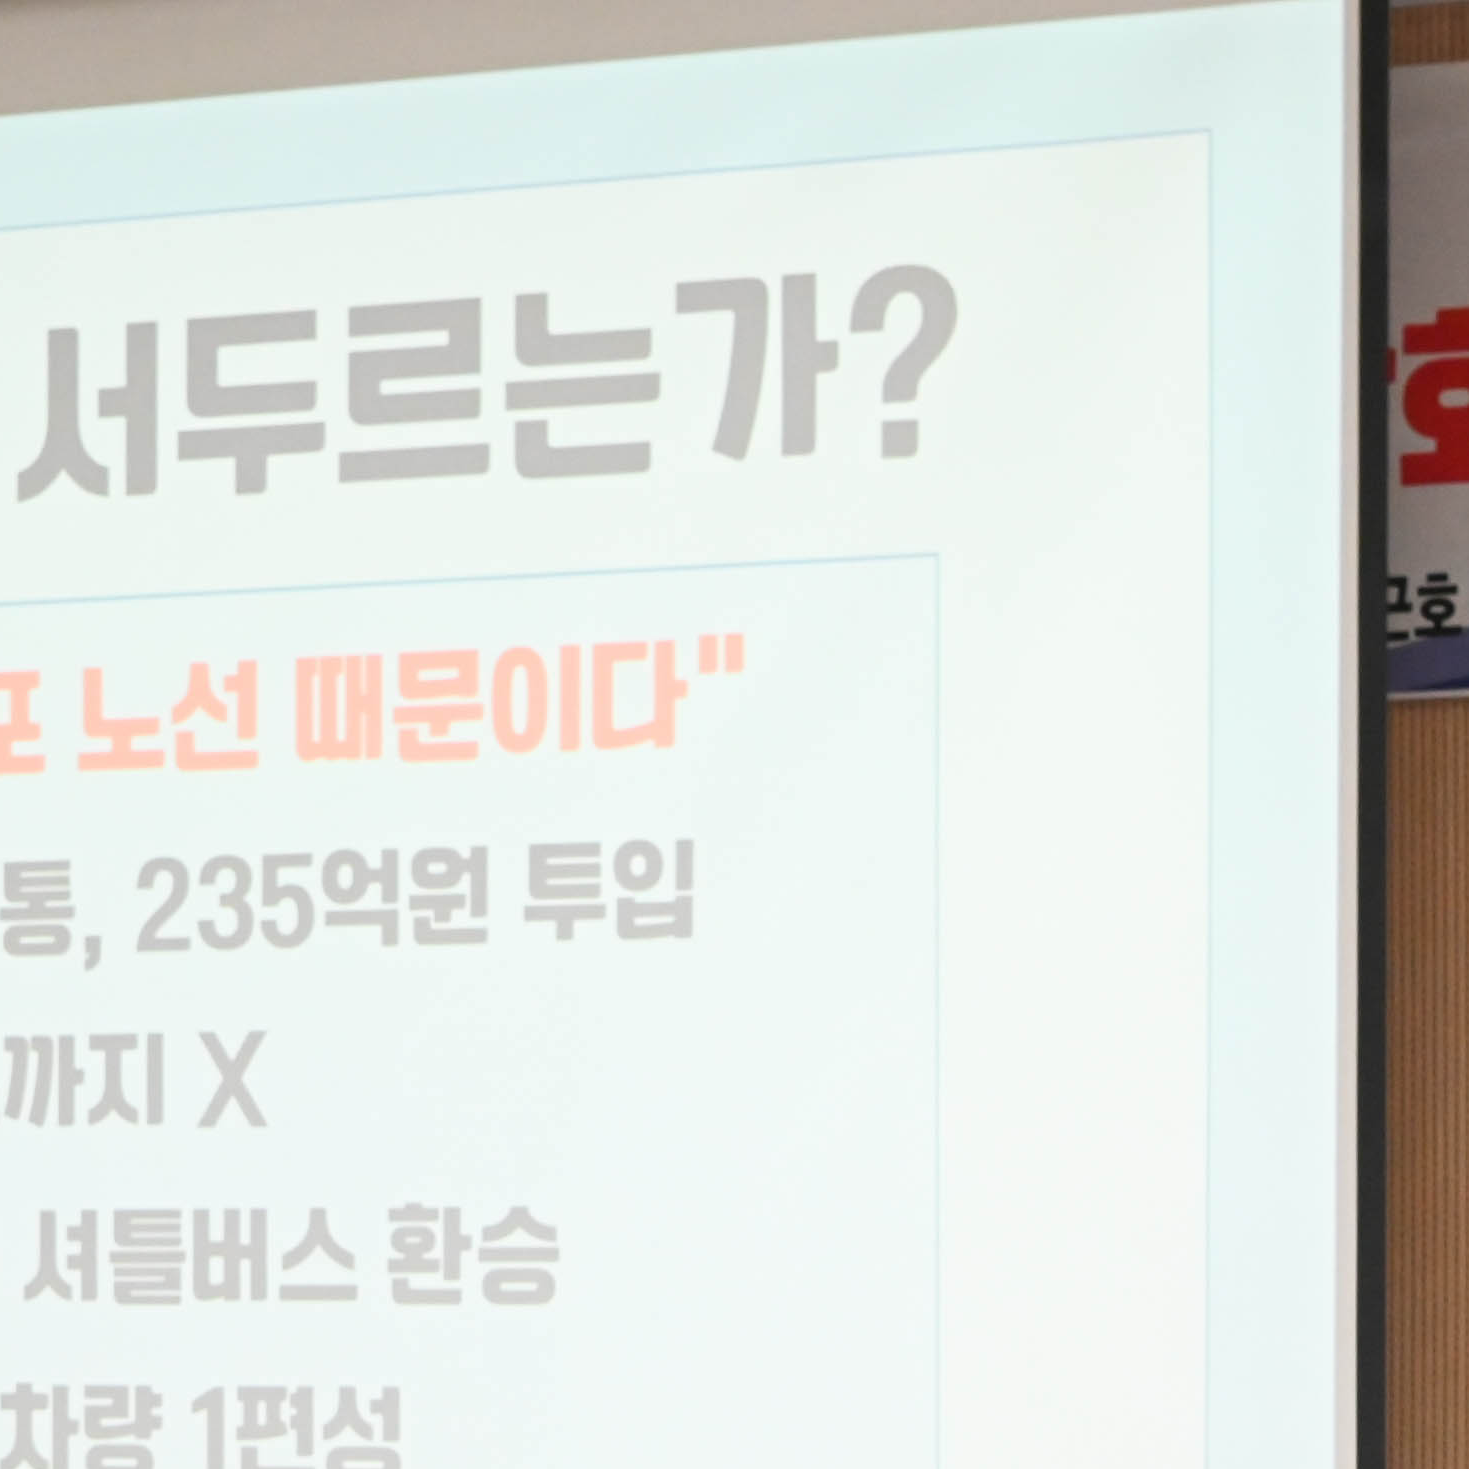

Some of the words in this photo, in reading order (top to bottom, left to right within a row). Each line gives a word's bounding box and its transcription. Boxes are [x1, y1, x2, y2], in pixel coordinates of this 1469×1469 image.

[16, 264, 959, 502] 서두르는가?
[77, 659, 259, 771] 노선
[294, 633, 745, 763] 때문이다"
[135, 845, 489, 953] 235억원
[523, 838, 695, 942] 투입
[197, 1029, 268, 1129] X
[23, 1207, 359, 1306] 셔틀버스
[387, 1202, 560, 1306] 환승
